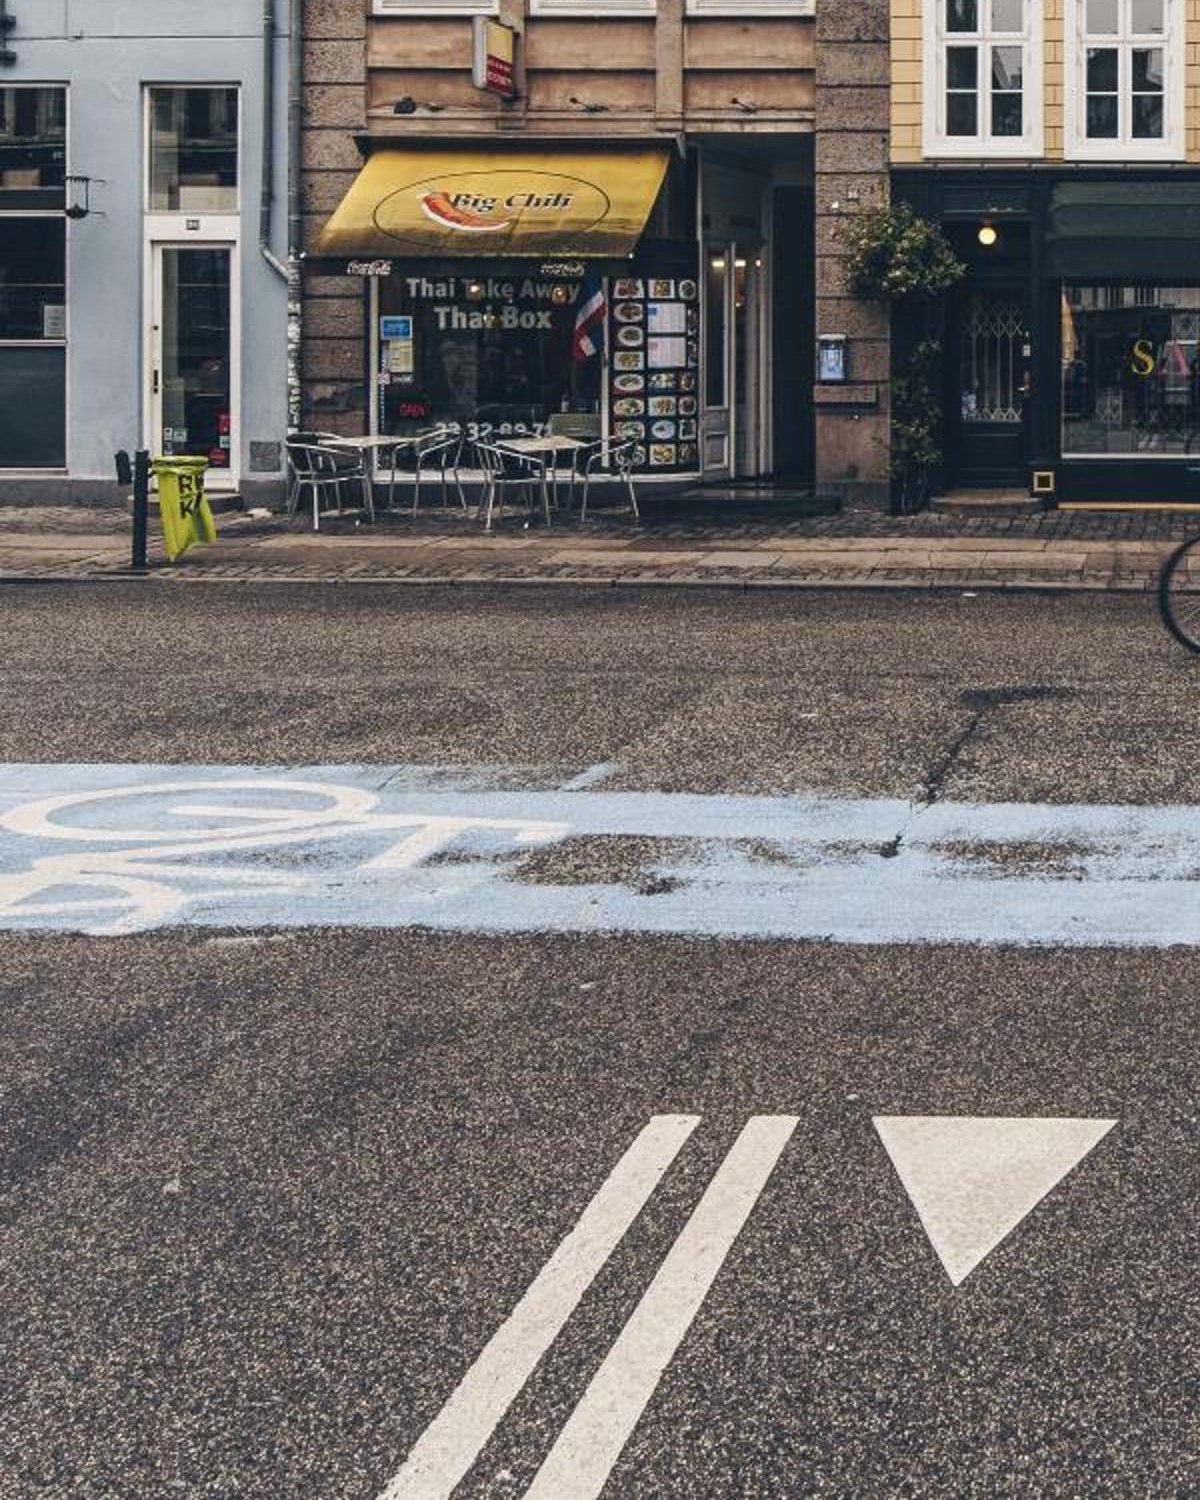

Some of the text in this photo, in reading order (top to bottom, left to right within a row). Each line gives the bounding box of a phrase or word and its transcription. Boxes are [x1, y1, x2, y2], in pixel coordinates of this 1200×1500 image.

[452, 193, 573, 213] Big Chili
[406, 277, 456, 299] Thai
[433, 306, 494, 330] Thai
[502, 306, 553, 330] Box
